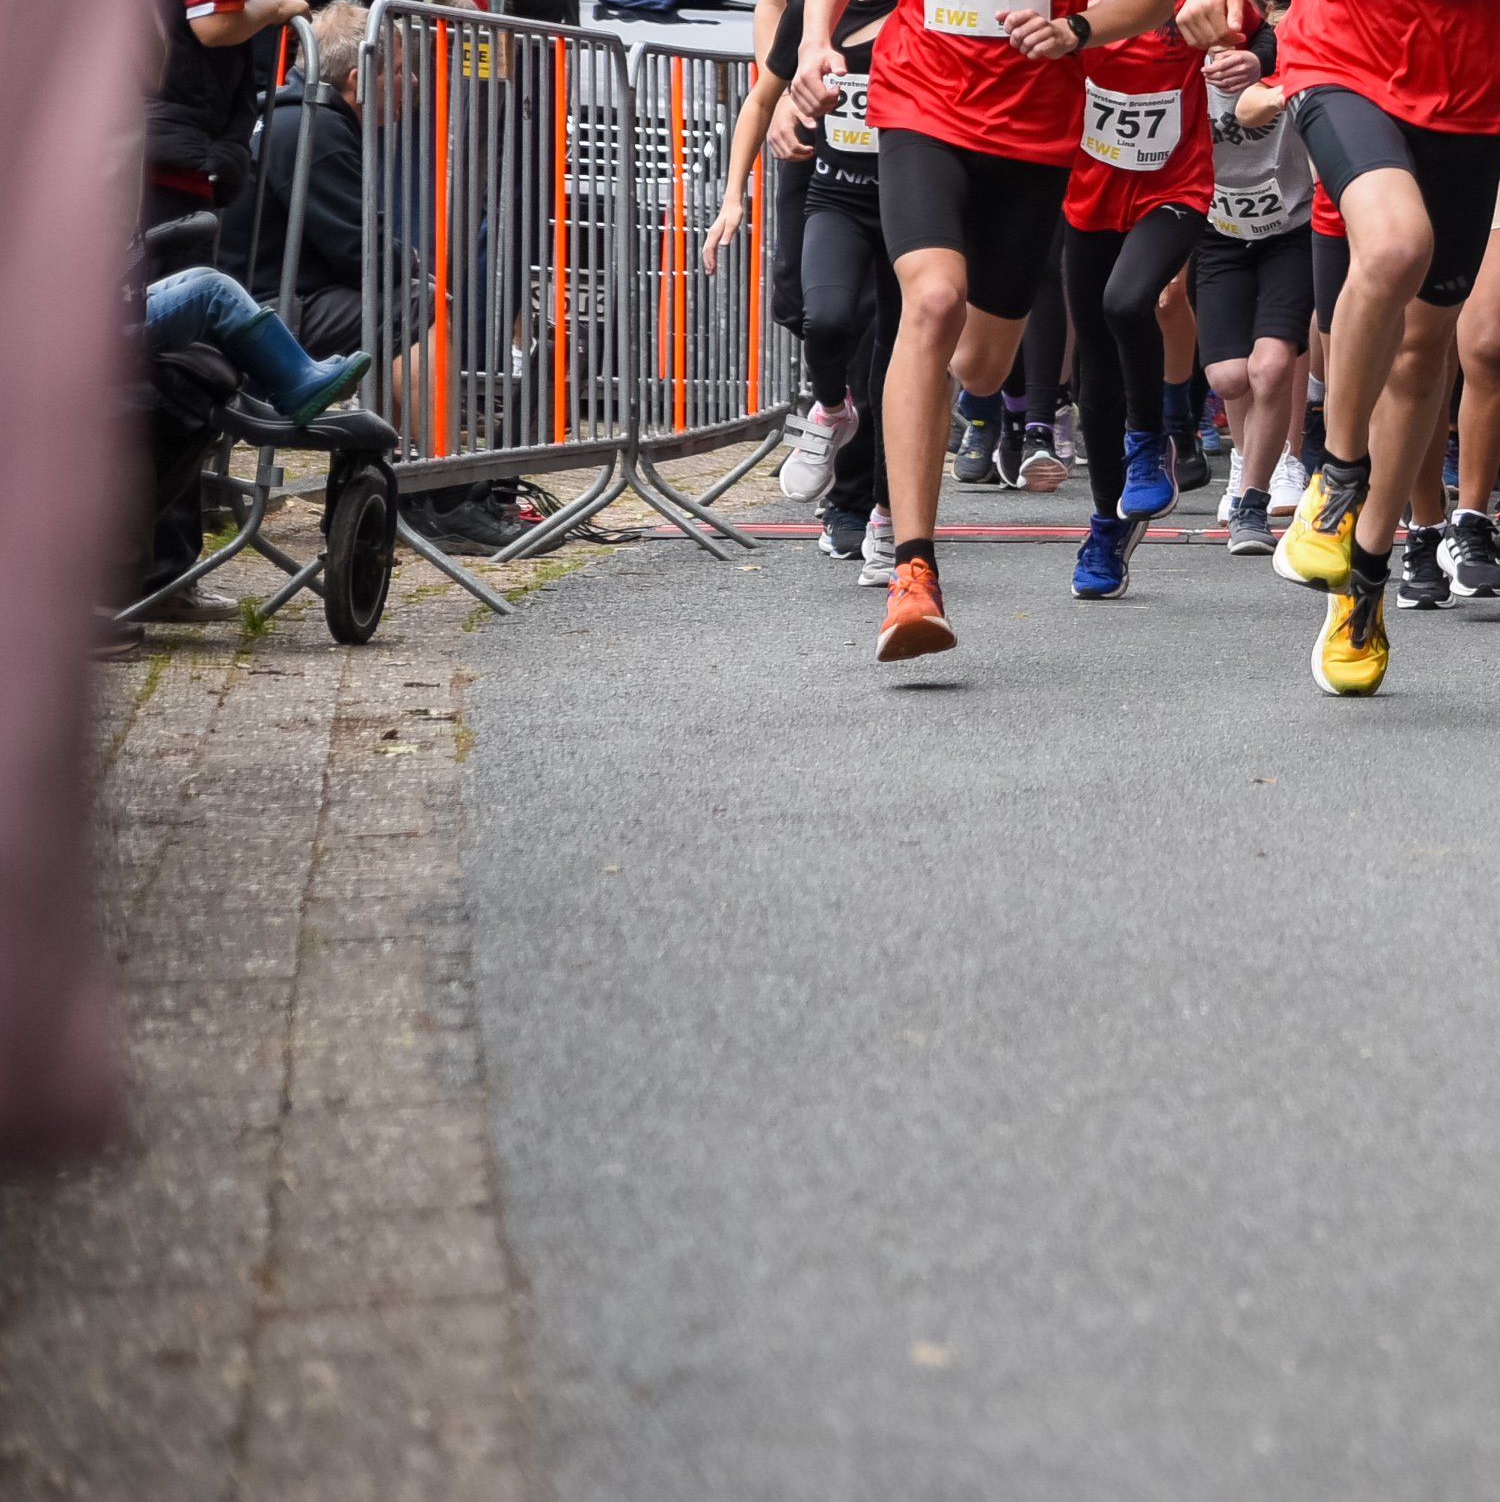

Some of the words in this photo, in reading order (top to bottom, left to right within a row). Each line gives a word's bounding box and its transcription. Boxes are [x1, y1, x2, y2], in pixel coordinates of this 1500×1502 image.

[935, 8, 979, 28] EWE
[1087, 88, 1127, 107] Everstener
[1129, 98, 1175, 107] Brunnenlauf
[1093, 101, 1166, 139] 757
[833, 129, 871, 146] EWE
[1117, 139, 1135, 148] Lina
[1086, 136, 1121, 160] EWE
[1136, 149, 1170, 162] bruns
[1210, 193, 1282, 218] 122
[1251, 219, 1282, 234] bruns
